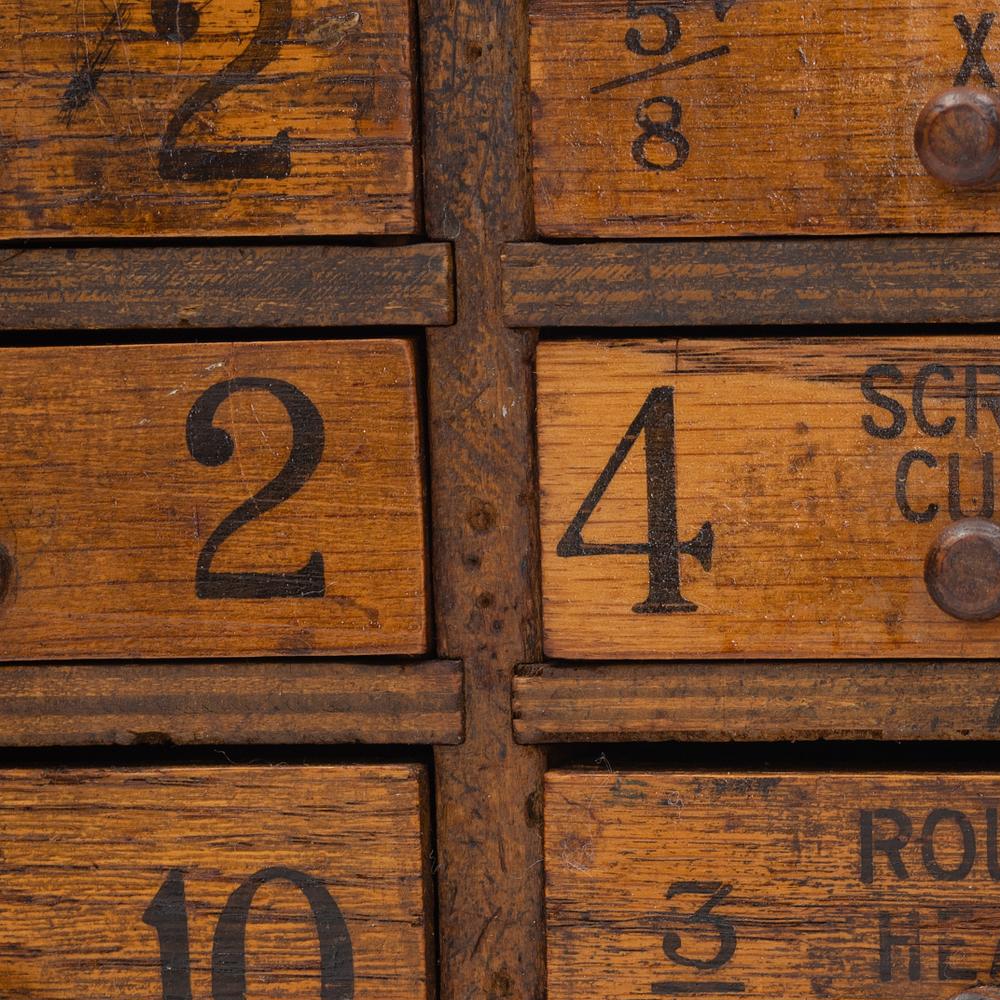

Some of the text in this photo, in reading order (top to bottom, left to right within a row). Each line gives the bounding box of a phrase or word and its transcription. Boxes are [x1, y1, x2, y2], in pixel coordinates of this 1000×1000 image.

[150, 0, 294, 180] 2
[632, 96, 689, 171] 8
[185, 376, 325, 599] 2
[556, 385, 713, 613] 4
[662, 881, 738, 970] 3
